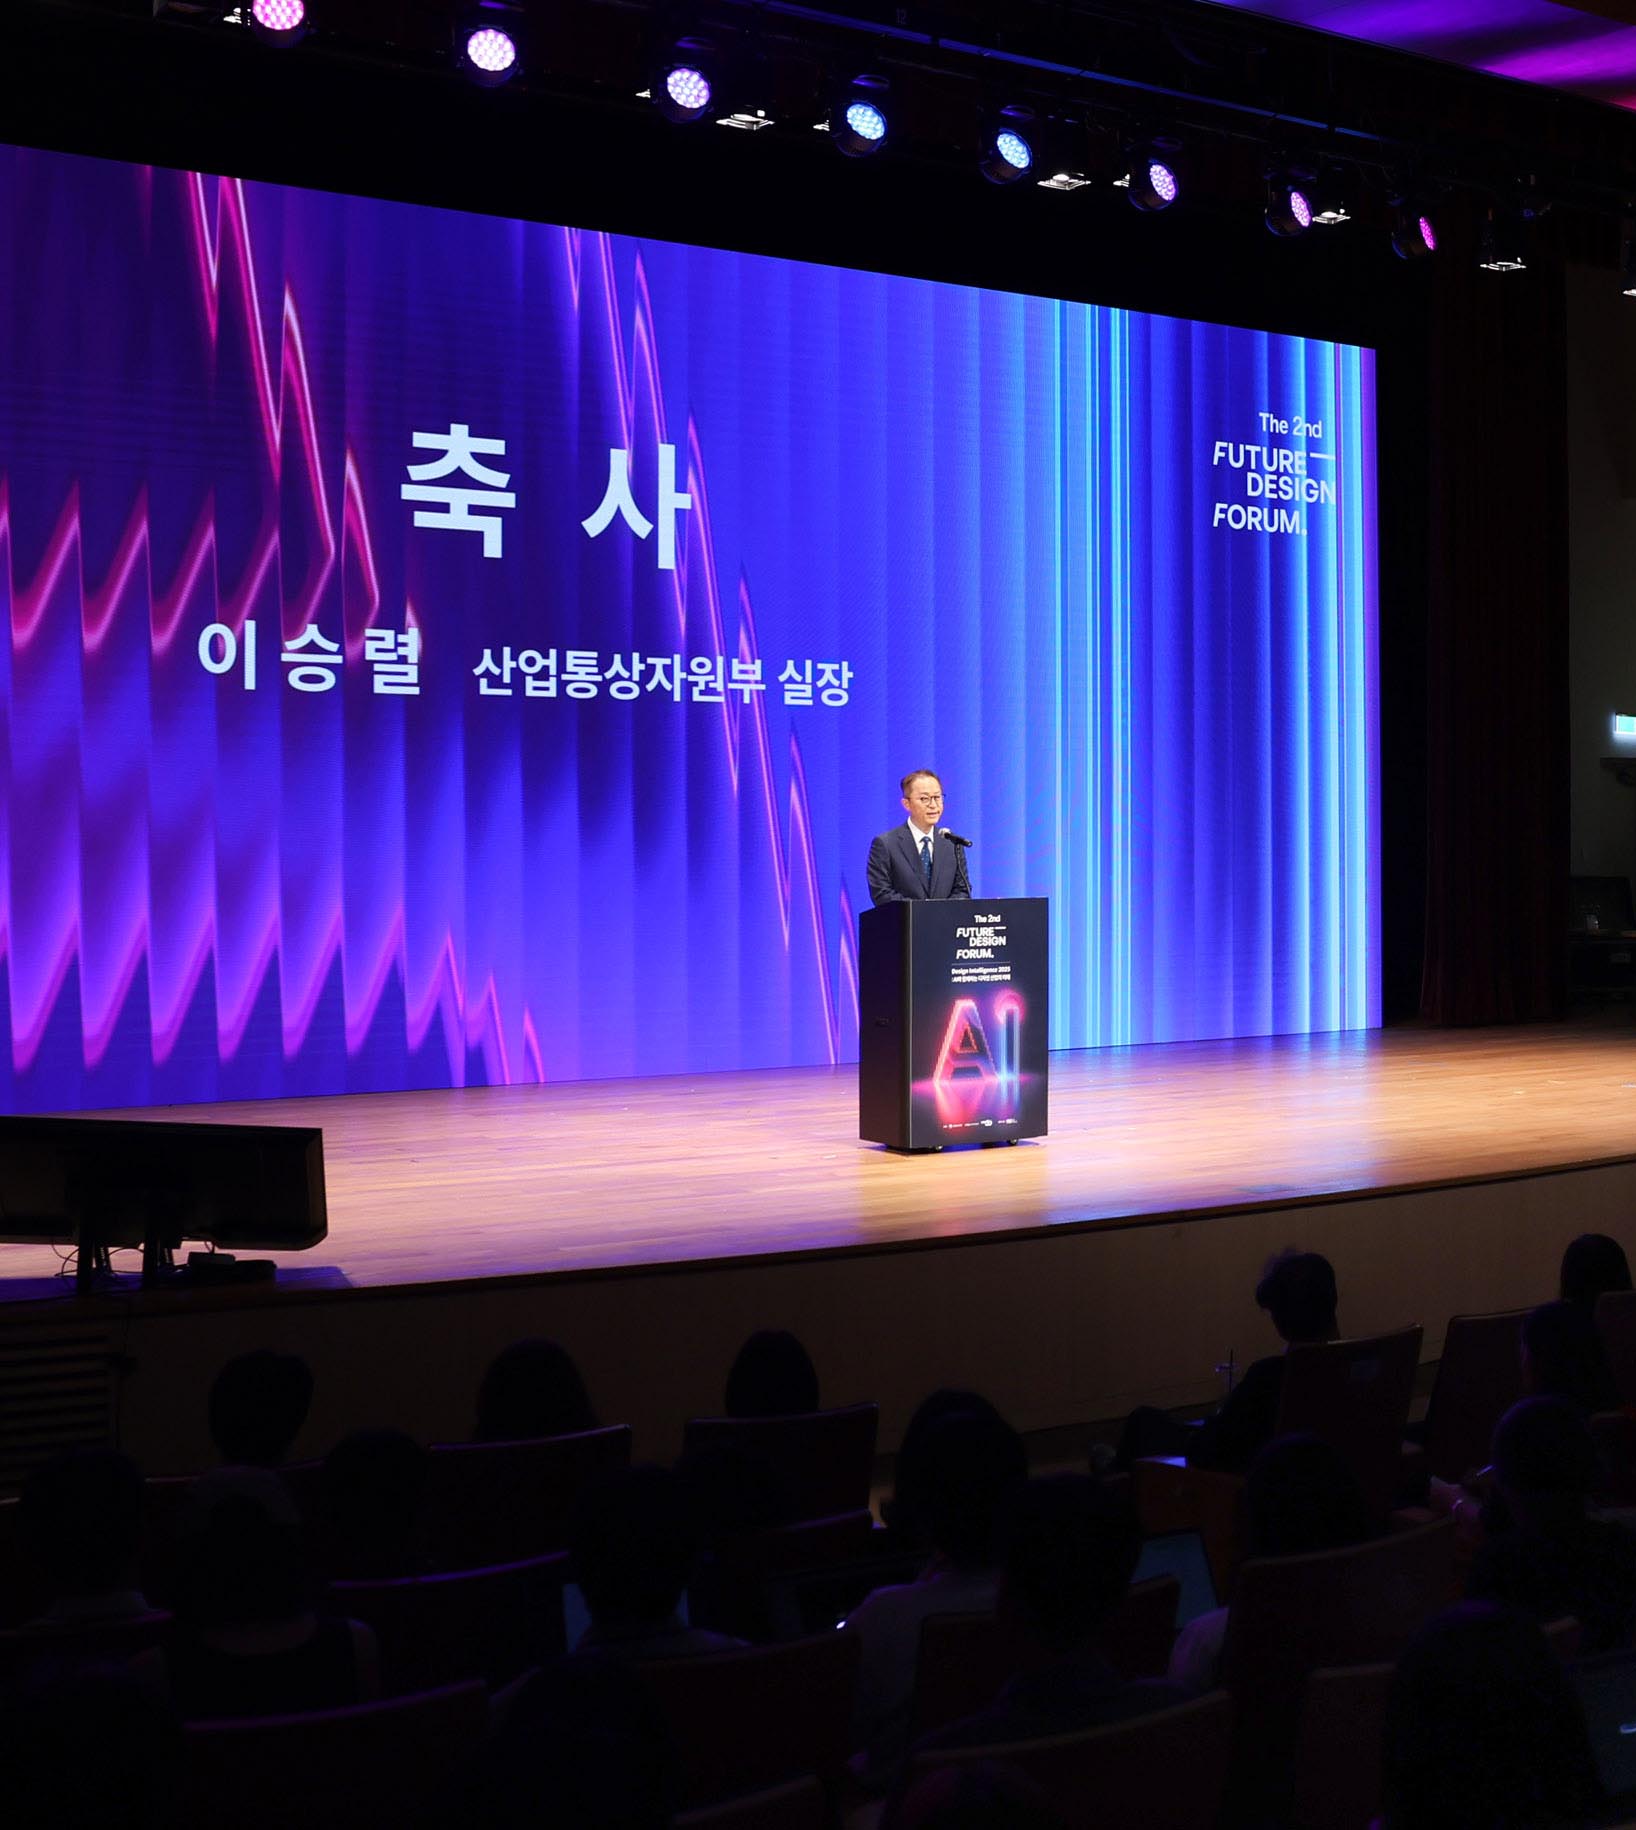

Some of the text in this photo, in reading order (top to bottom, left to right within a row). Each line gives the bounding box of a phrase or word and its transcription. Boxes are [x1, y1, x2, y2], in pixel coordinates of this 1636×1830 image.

[1259, 412, 1322, 438] The 2nd
[1213, 441, 1307, 475] FUTURE
[400, 422, 692, 570] 축 사
[1247, 471, 1336, 505] DESIGN
[1213, 503, 1308, 536] FORUM.
[472, 647, 766, 704] 산업통상자원부
[777, 657, 853, 707] 실장
[956, 927, 995, 938] FUTURE
[974, 914, 1001, 923] The 2nd
[956, 948, 995, 959] FORUM.
[969, 936, 1007, 947] DESIGN
